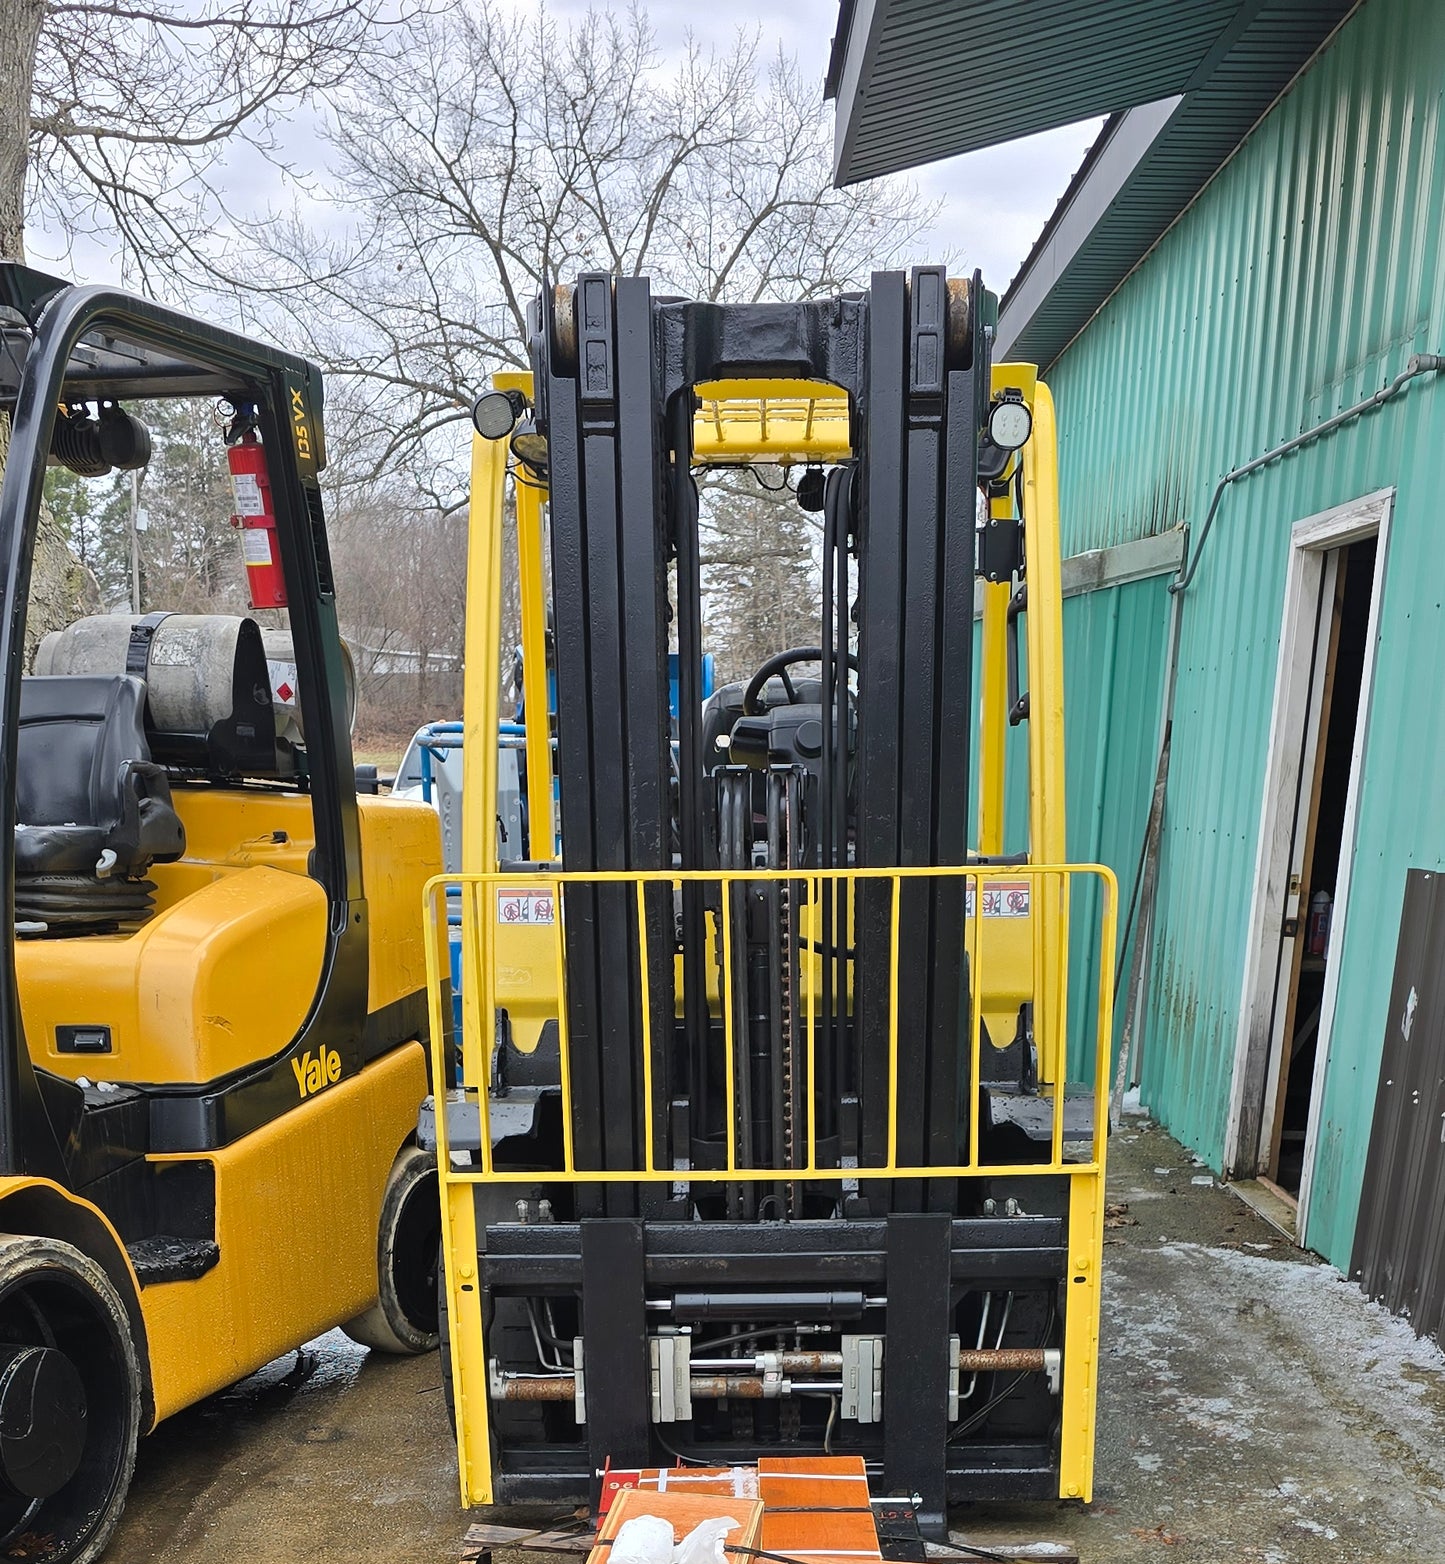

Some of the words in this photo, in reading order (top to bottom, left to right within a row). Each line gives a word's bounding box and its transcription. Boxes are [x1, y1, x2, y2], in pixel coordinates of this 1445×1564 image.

[290, 386, 305, 421] VX
[295, 425, 311, 459] 135
[291, 1044, 341, 1098] Yale
